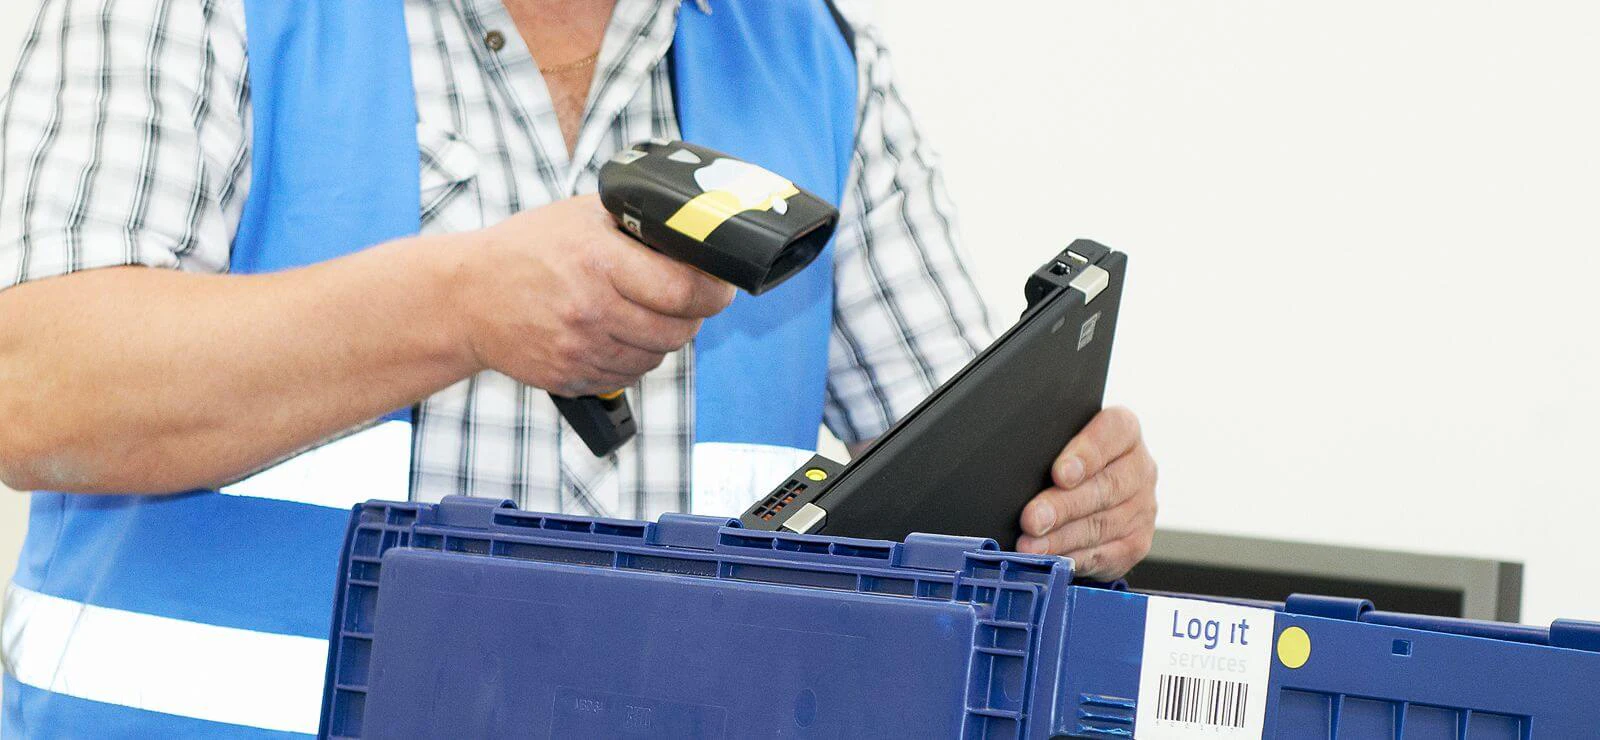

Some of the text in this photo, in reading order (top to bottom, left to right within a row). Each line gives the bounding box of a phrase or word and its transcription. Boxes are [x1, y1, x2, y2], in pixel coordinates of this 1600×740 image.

[1172, 609, 1249, 650] Log it
[1169, 651, 1248, 673] services
